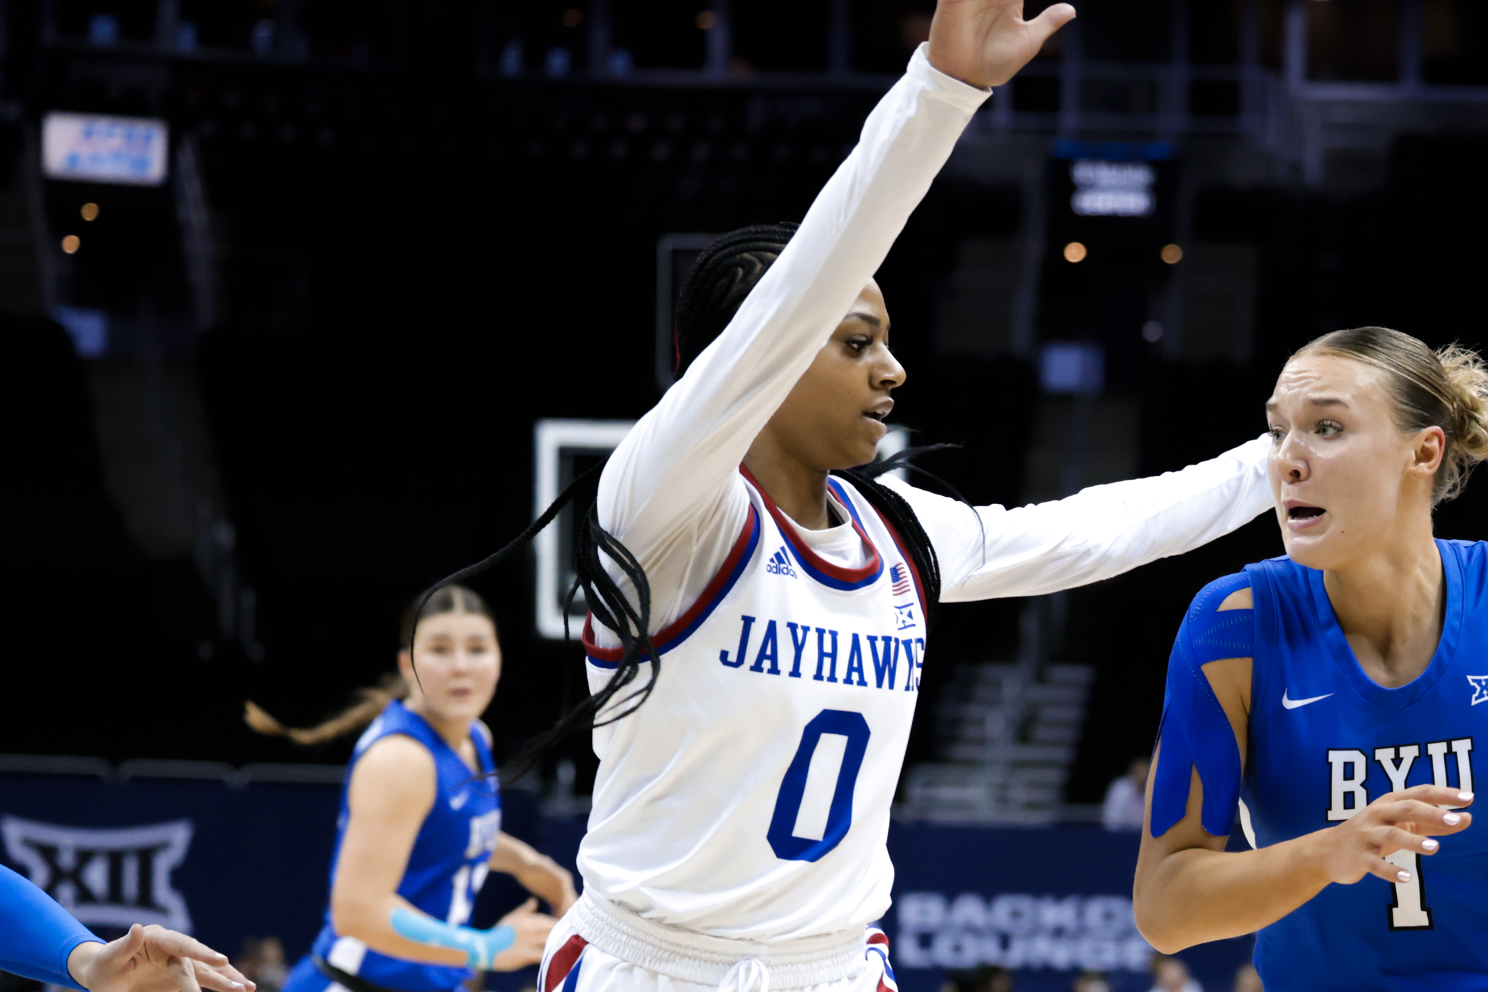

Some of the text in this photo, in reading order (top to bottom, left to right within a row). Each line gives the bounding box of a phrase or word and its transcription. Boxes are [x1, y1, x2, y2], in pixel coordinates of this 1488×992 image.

[766, 563, 798, 579] adidas
[766, 709, 871, 862] 0
[1326, 736, 1474, 822] BYU
[1382, 847, 1434, 931] 1
